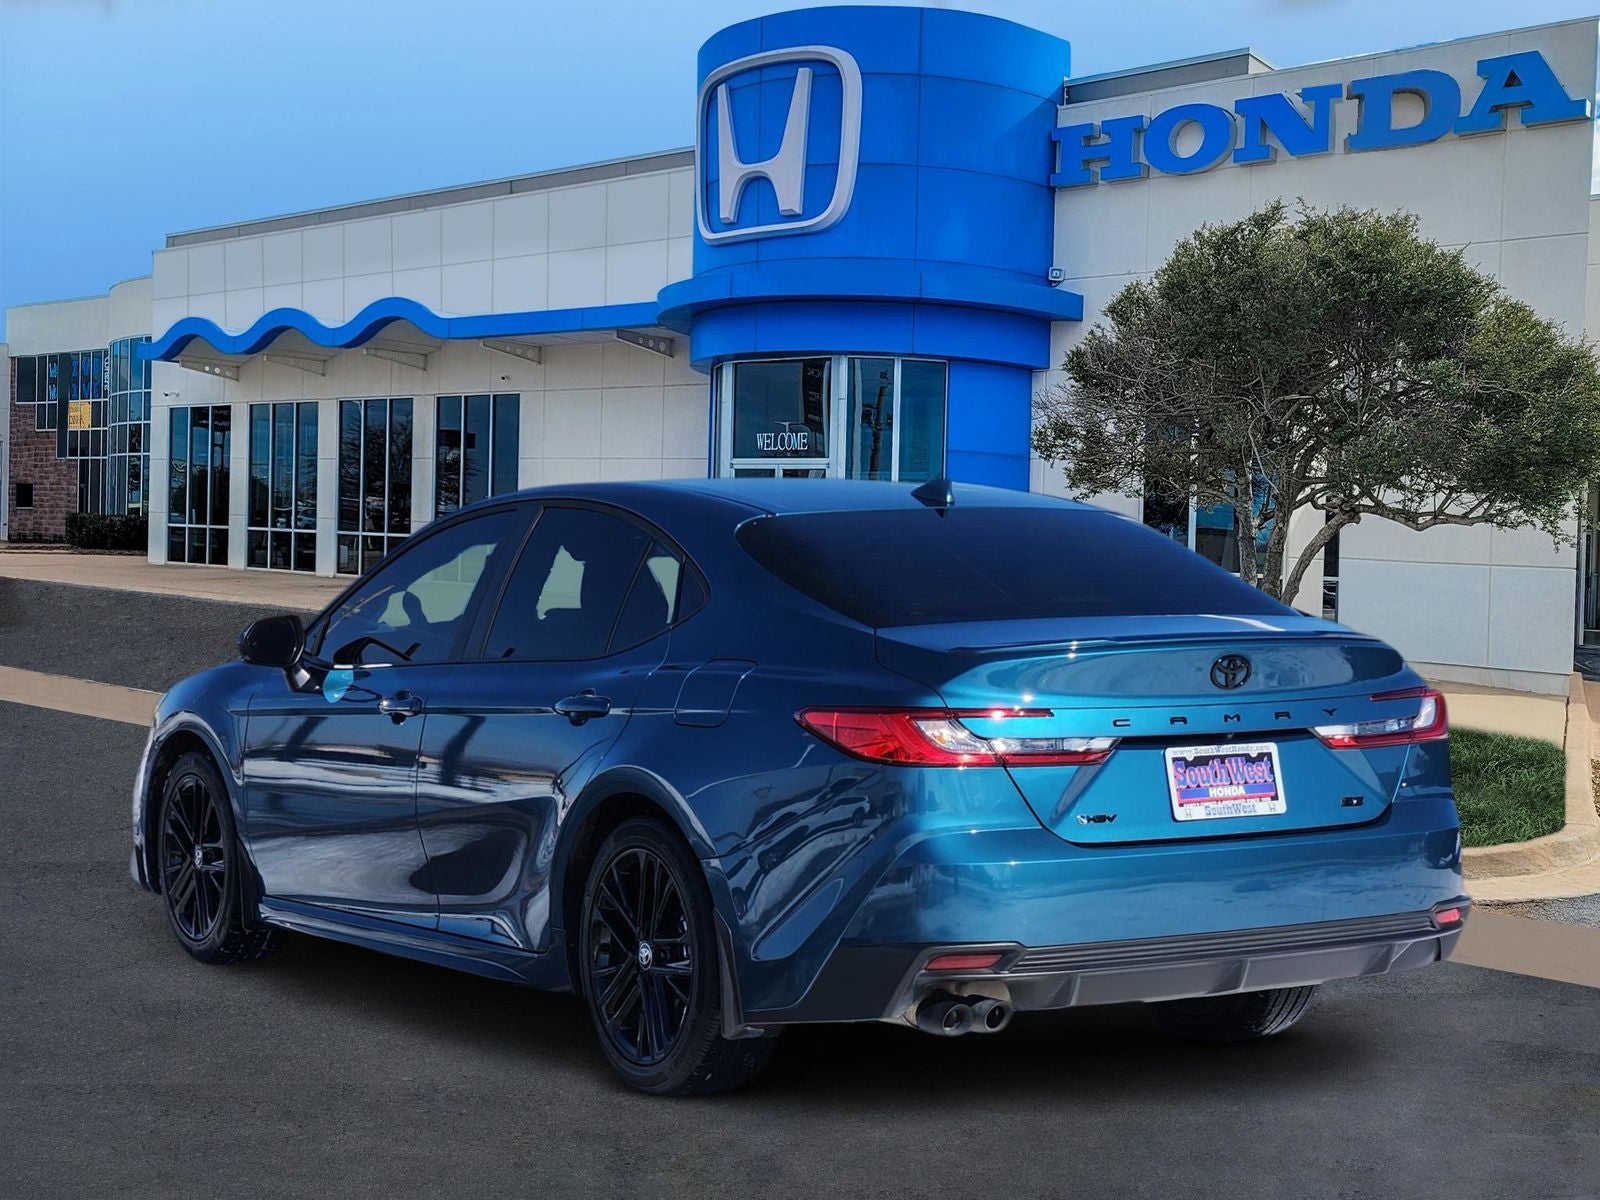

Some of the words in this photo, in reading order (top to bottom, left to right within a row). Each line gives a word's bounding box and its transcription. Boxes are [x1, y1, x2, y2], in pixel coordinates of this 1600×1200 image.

[1051, 50, 1591, 188] HONDA
[756, 432, 808, 450] WELCOME
[1112, 707, 1339, 728] CAMRY
[1209, 784, 1246, 798] HONDA
